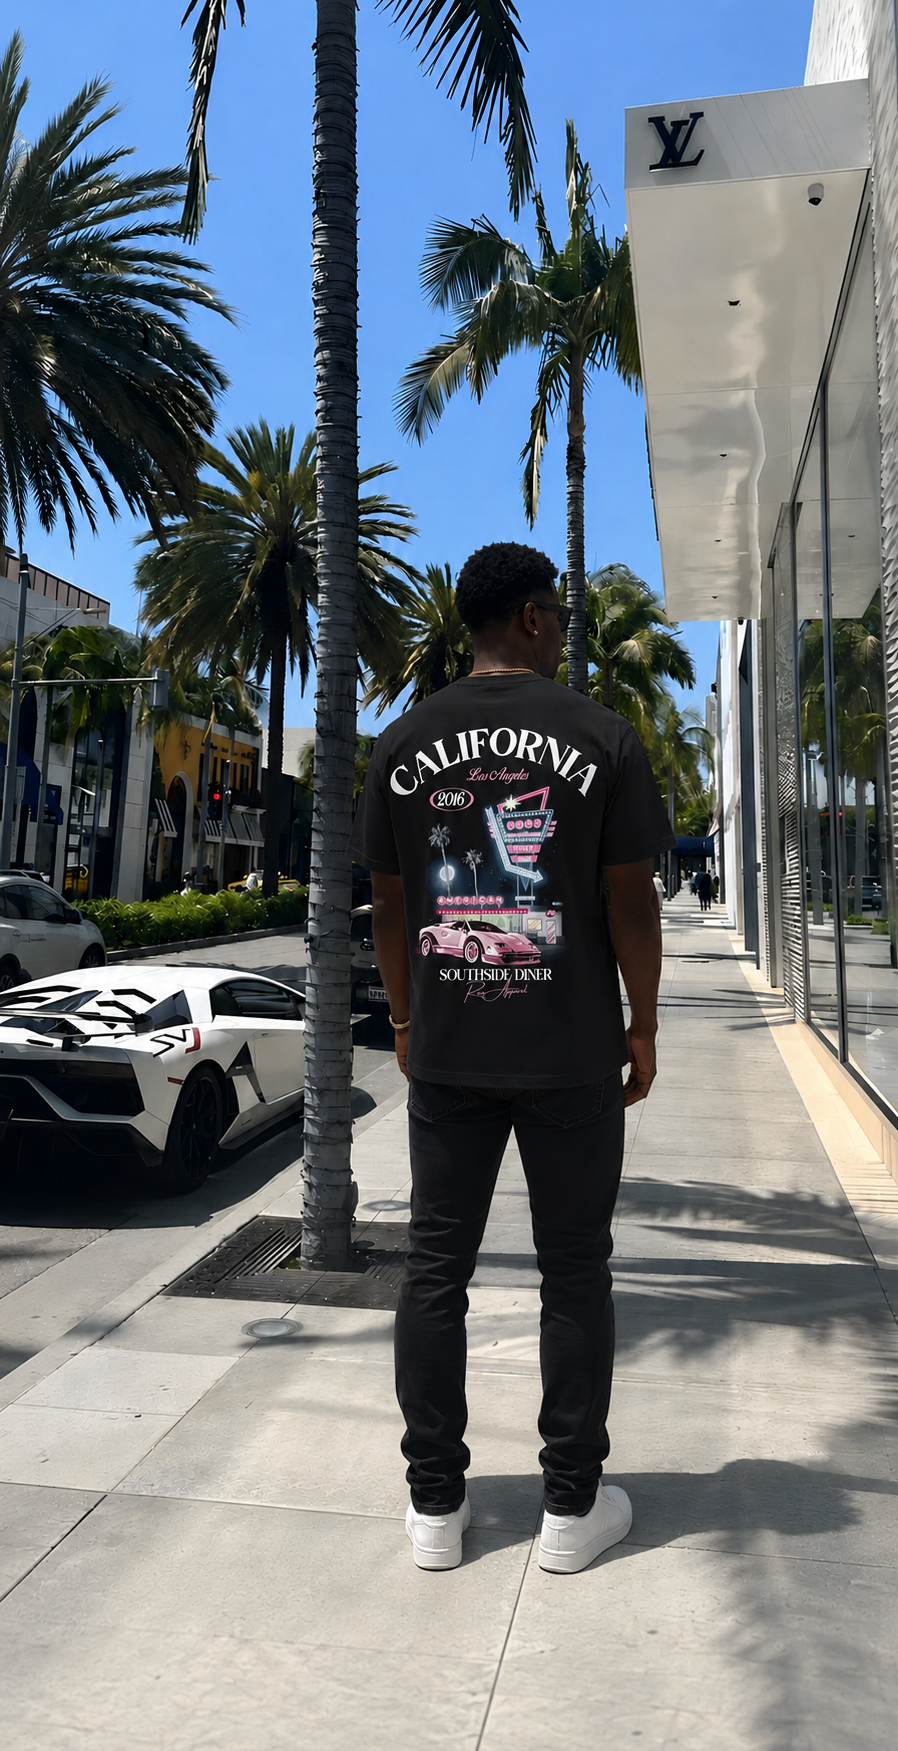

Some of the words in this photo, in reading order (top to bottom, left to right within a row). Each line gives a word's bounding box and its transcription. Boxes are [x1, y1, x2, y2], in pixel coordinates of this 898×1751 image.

[390, 727, 598, 797] CALIFORNIA
[466, 767, 488, 781] Los
[489, 766, 530, 784] Angeles
[437, 791, 466, 807] 2016
[439, 968, 511, 981] SOUTHSIDE
[514, 968, 552, 981] DINER
